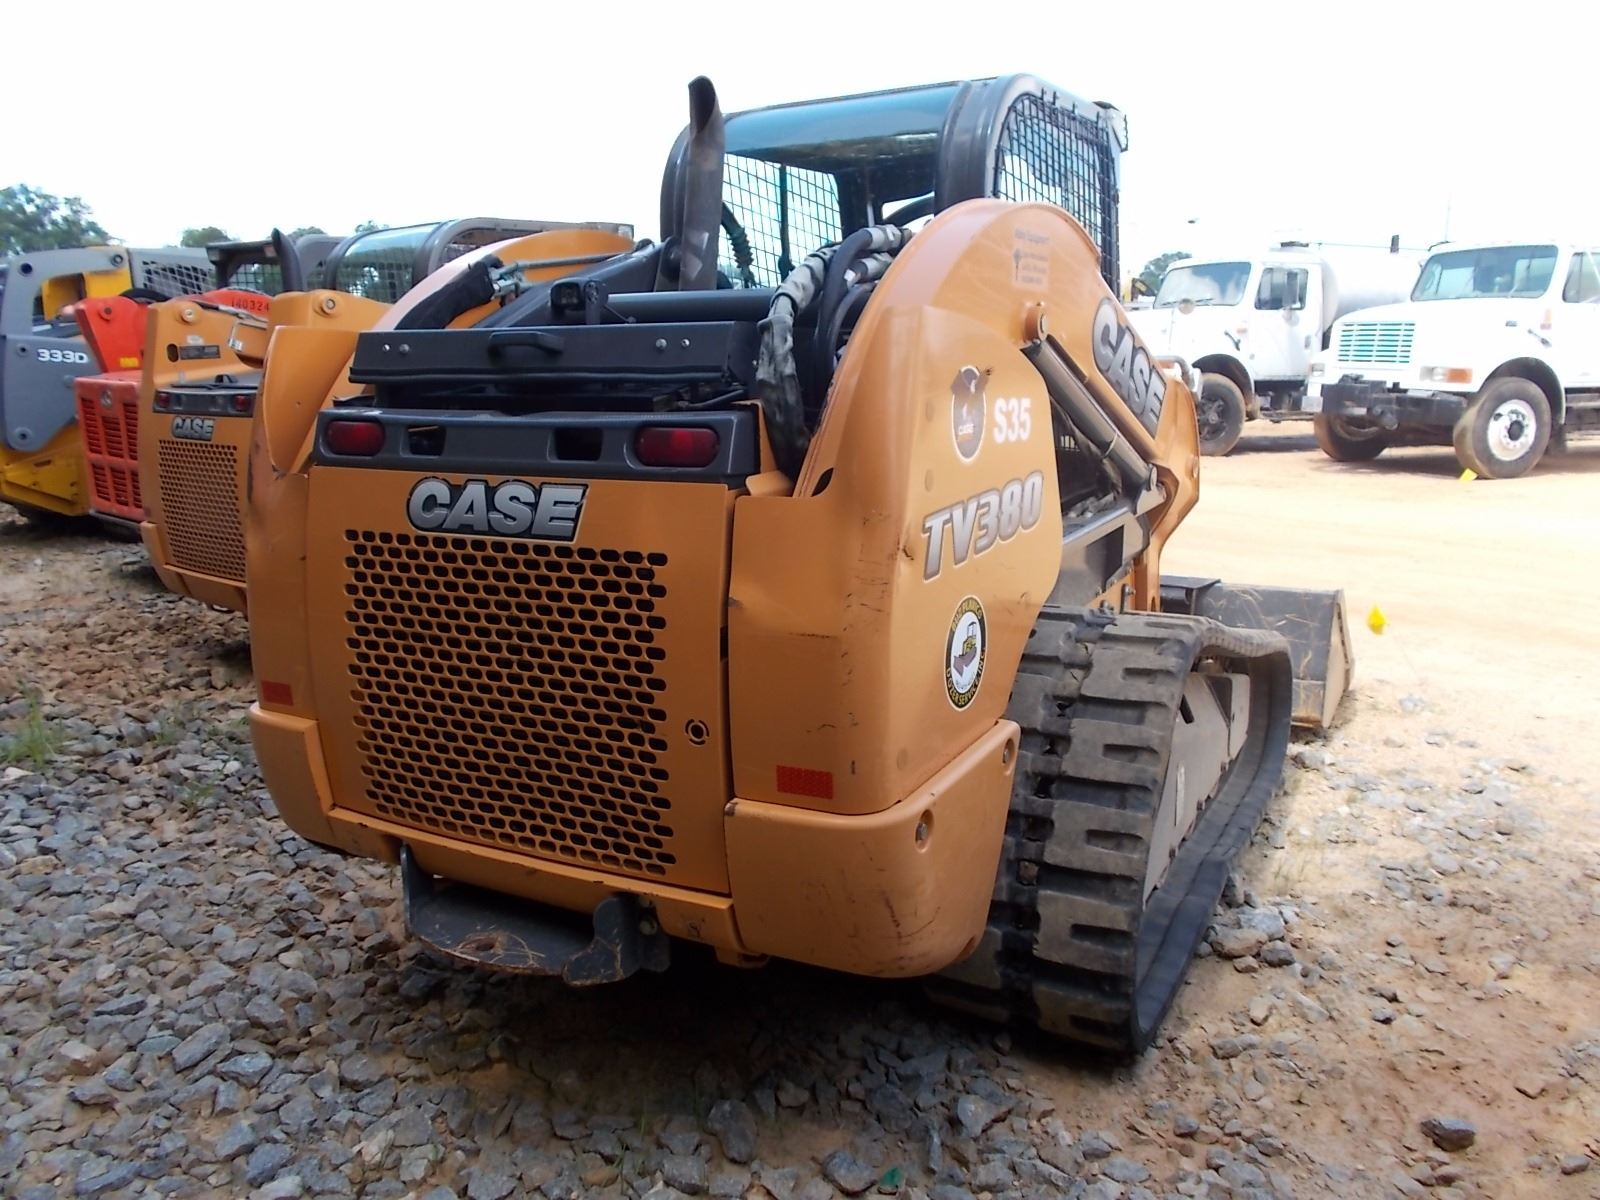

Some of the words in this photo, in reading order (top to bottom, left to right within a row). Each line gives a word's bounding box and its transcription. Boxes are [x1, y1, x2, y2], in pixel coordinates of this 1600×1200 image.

[37, 348, 89, 364] 333D
[1092, 299, 1167, 440] CASE
[171, 416, 214, 441] CASE
[993, 397, 1032, 444] S35
[407, 477, 587, 541] CASE
[922, 470, 1044, 582] TV380
